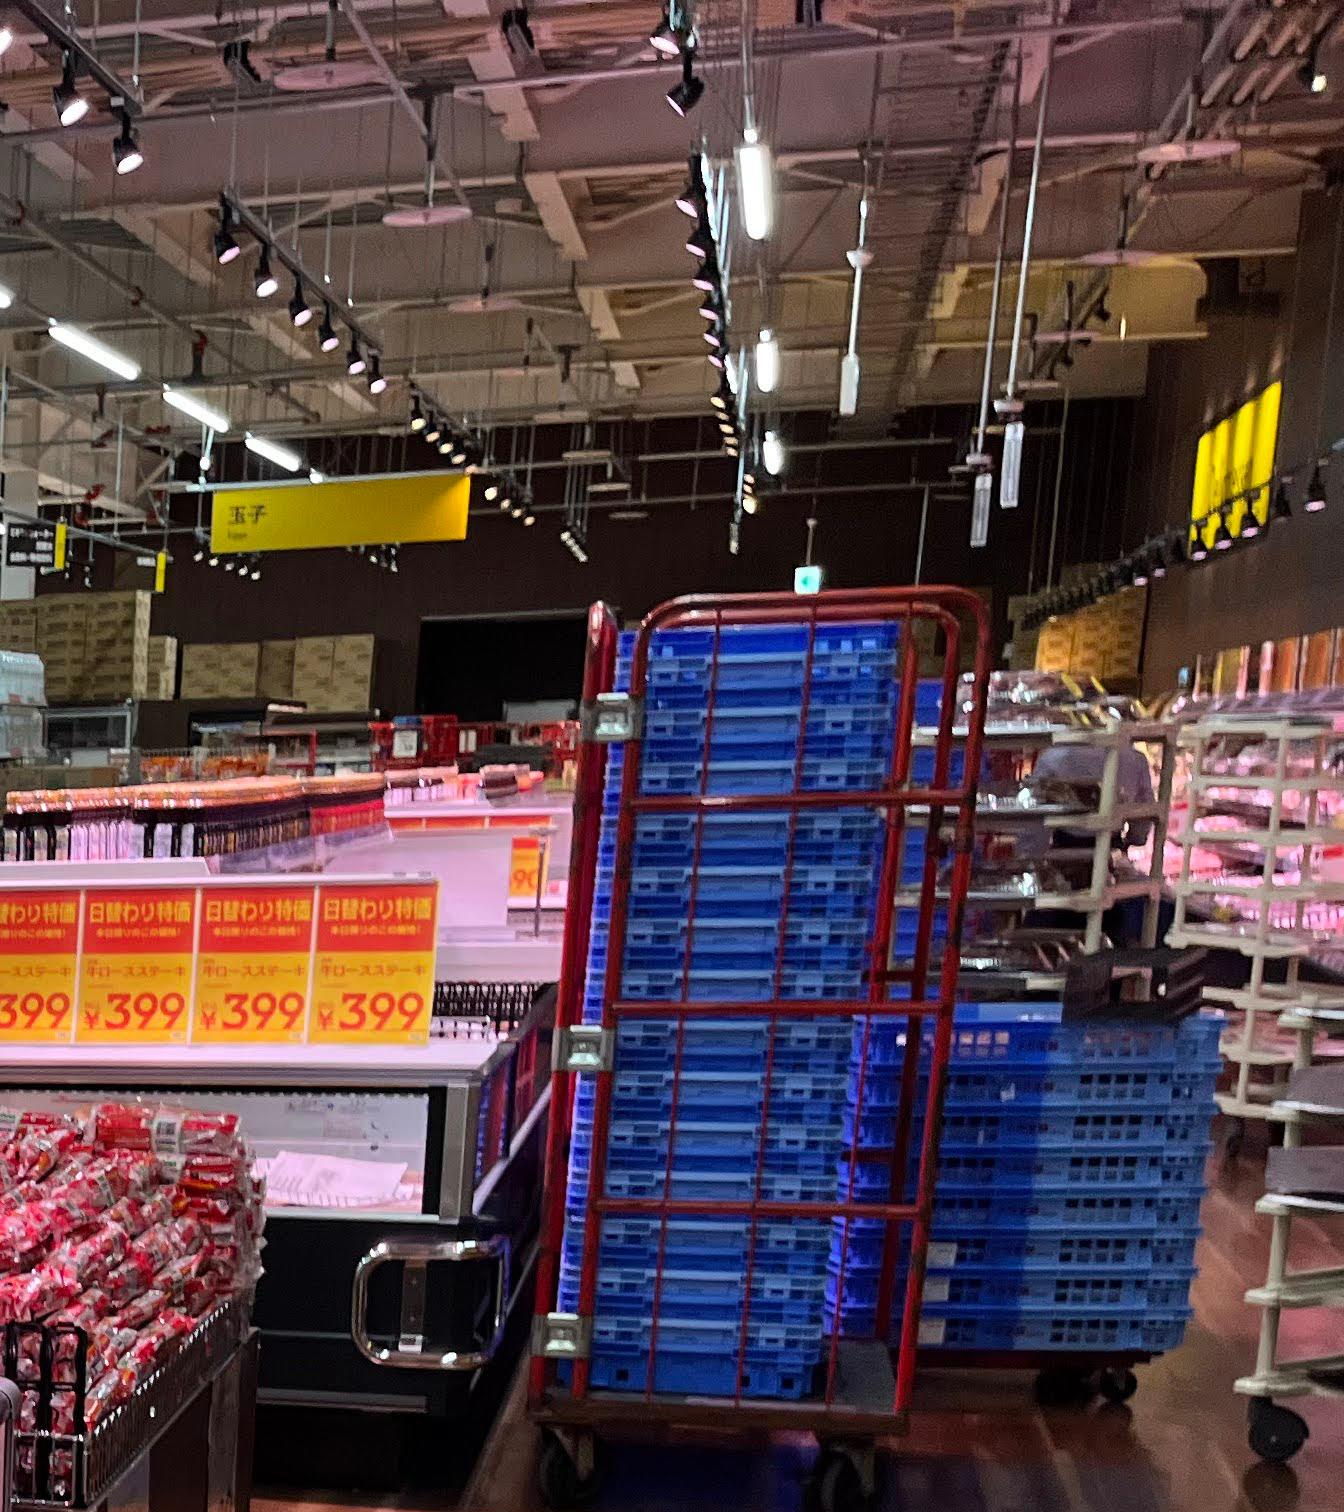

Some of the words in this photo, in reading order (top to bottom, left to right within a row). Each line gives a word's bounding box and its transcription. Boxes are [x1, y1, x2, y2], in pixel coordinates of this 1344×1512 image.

[89, 900, 191, 924] 日替わり特価
[206, 898, 311, 922] 日替わり特価
[324, 896, 432, 921] 日替わり特価
